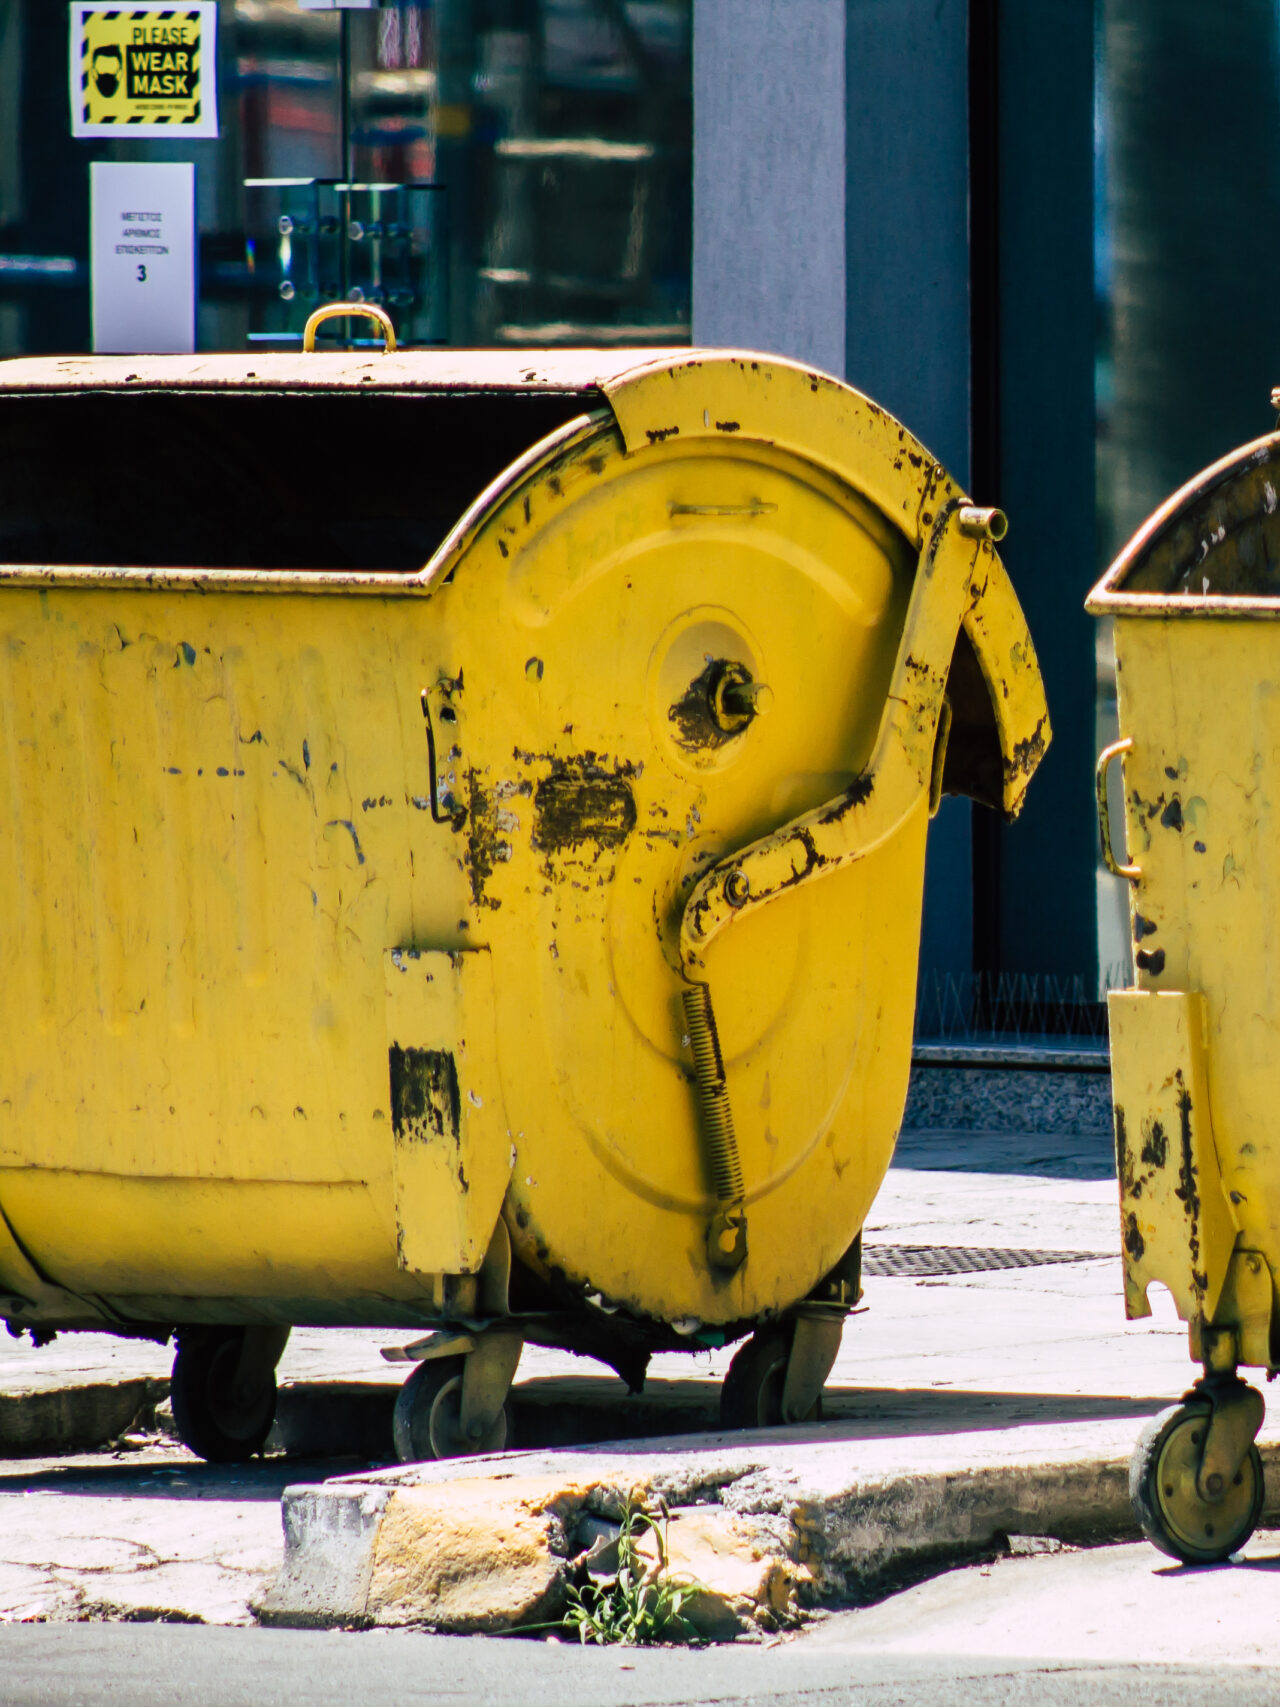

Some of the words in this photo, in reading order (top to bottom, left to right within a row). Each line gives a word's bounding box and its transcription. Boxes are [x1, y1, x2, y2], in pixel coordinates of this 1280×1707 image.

[133, 27, 188, 45] PLEASE
[131, 52, 189, 71] WEAR
[133, 75, 188, 94] MASK
[136, 264, 147, 282] 3
